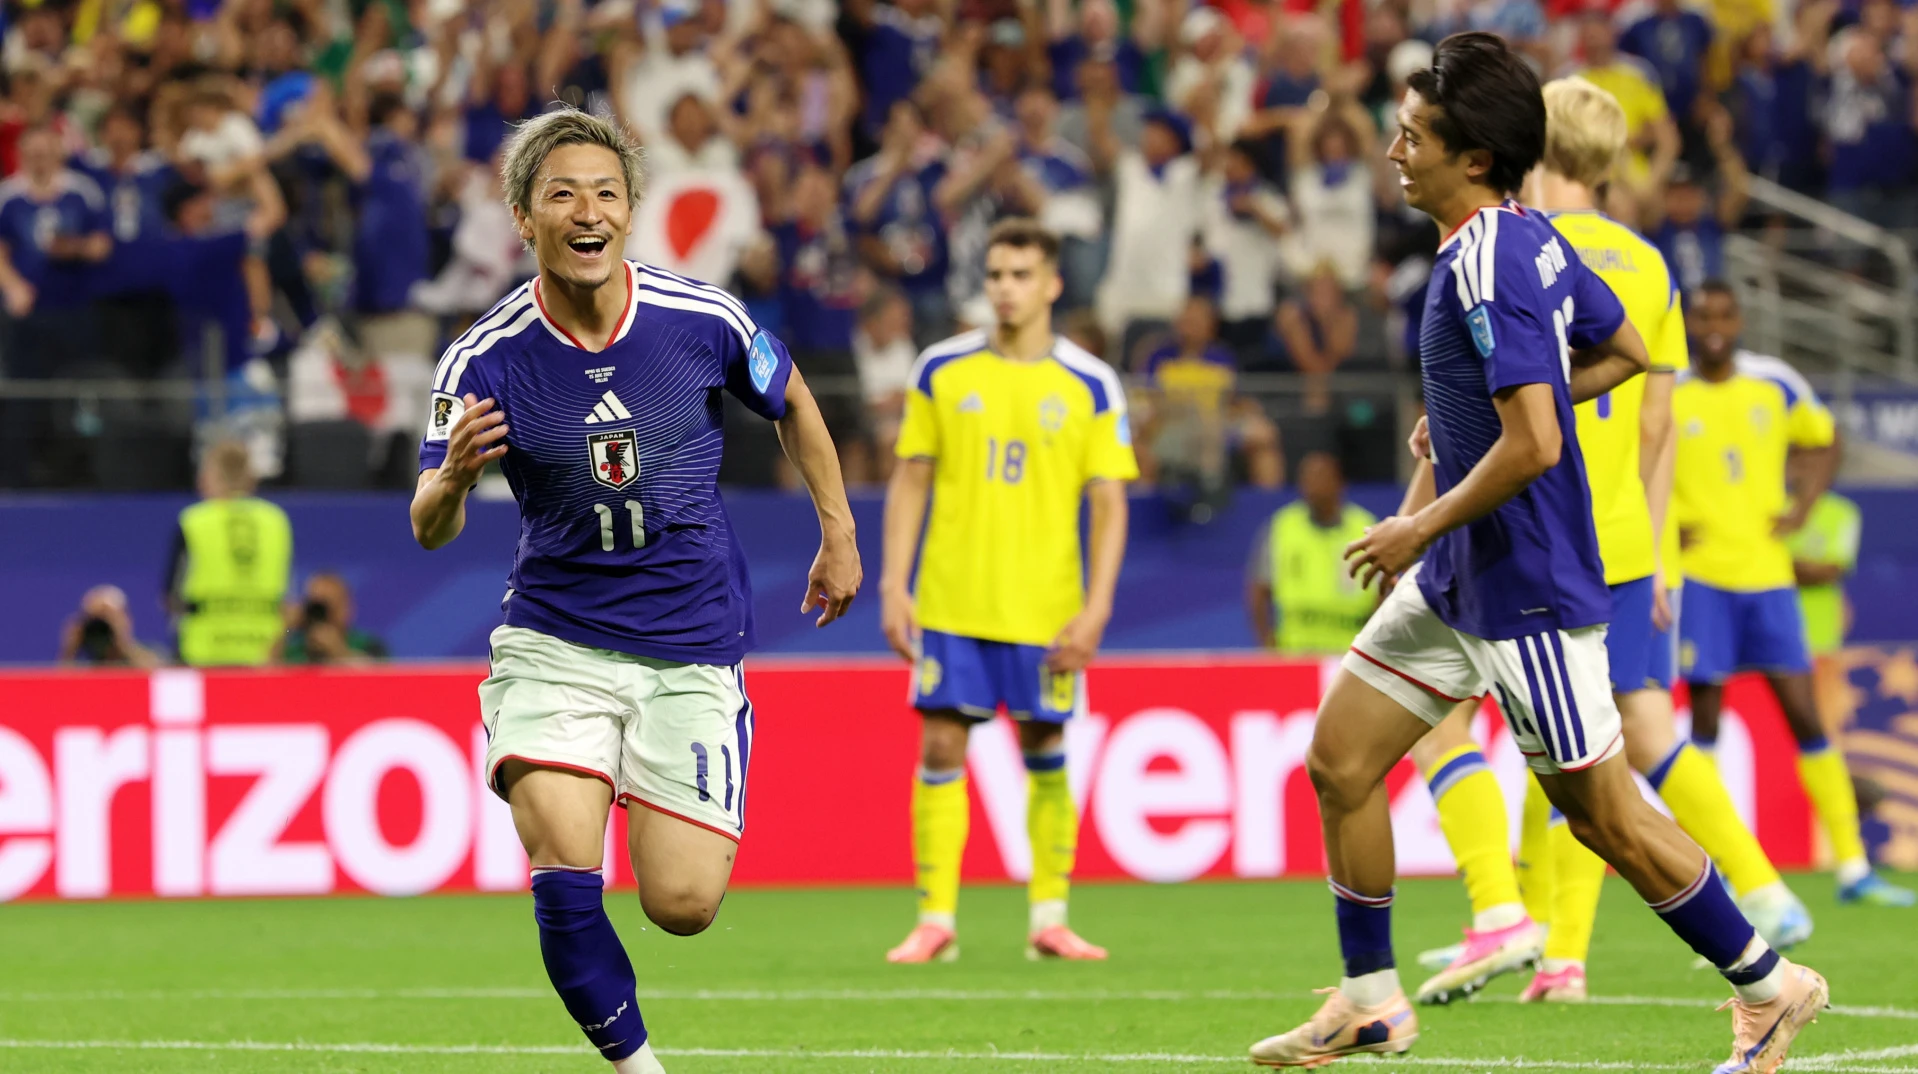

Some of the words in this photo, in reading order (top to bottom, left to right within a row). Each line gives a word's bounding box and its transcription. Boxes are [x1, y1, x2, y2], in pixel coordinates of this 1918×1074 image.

[599, 433, 624, 441] JAPAN
[985, 437, 1027, 485] 18
[606, 470, 628, 480] JFA
[593, 500, 646, 552] 11
[690, 741, 734, 812] 11
